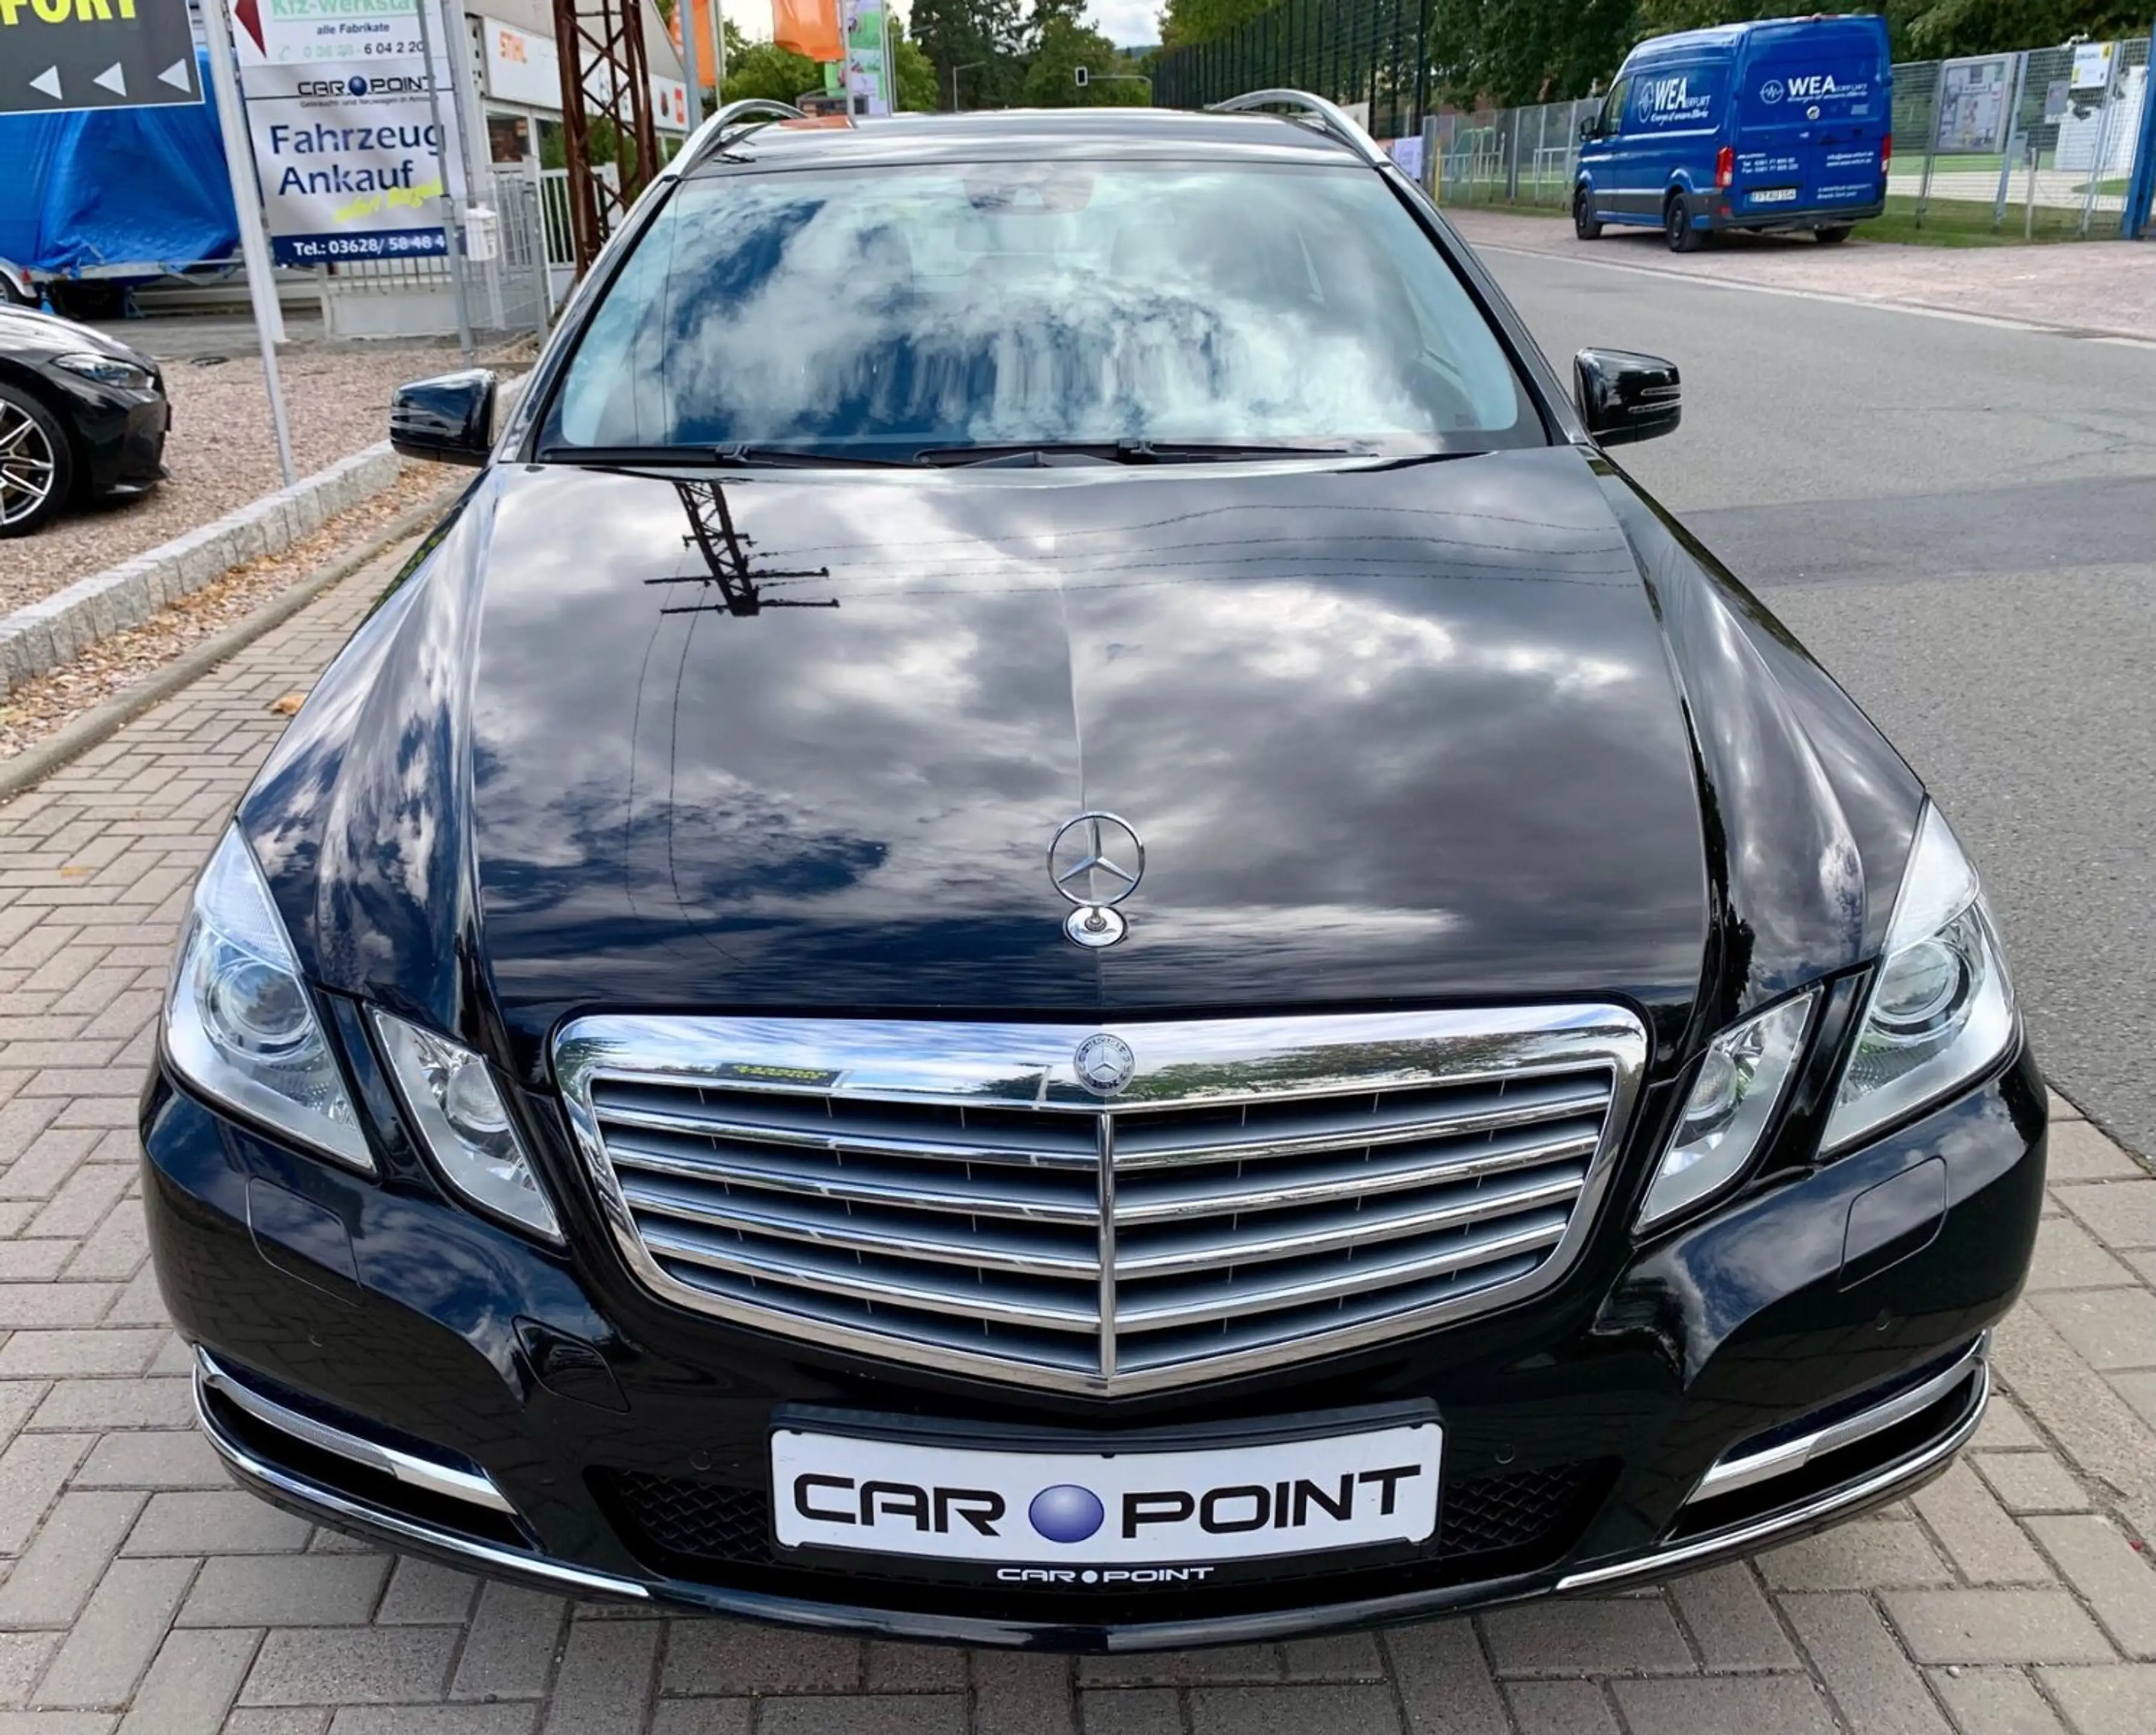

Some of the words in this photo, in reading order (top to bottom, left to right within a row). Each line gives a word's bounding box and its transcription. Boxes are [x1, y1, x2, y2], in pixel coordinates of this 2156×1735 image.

[316, 25, 336, 35] alle
[339, 23, 390, 34] Fabrikate
[297, 80, 345, 96] CAR
[1655, 76, 1687, 111] WEA
[1787, 74, 1835, 96] WEA
[269, 123, 445, 156] Fahrzeug
[278, 159, 415, 196] Ankauf
[293, 242, 327, 256] Tel.:
[794, 1473, 1006, 1537] CAR
[1122, 1465, 1421, 1539] POINT
[997, 1569, 1076, 1583] CAR
[1103, 1567, 1214, 1583] POINT
